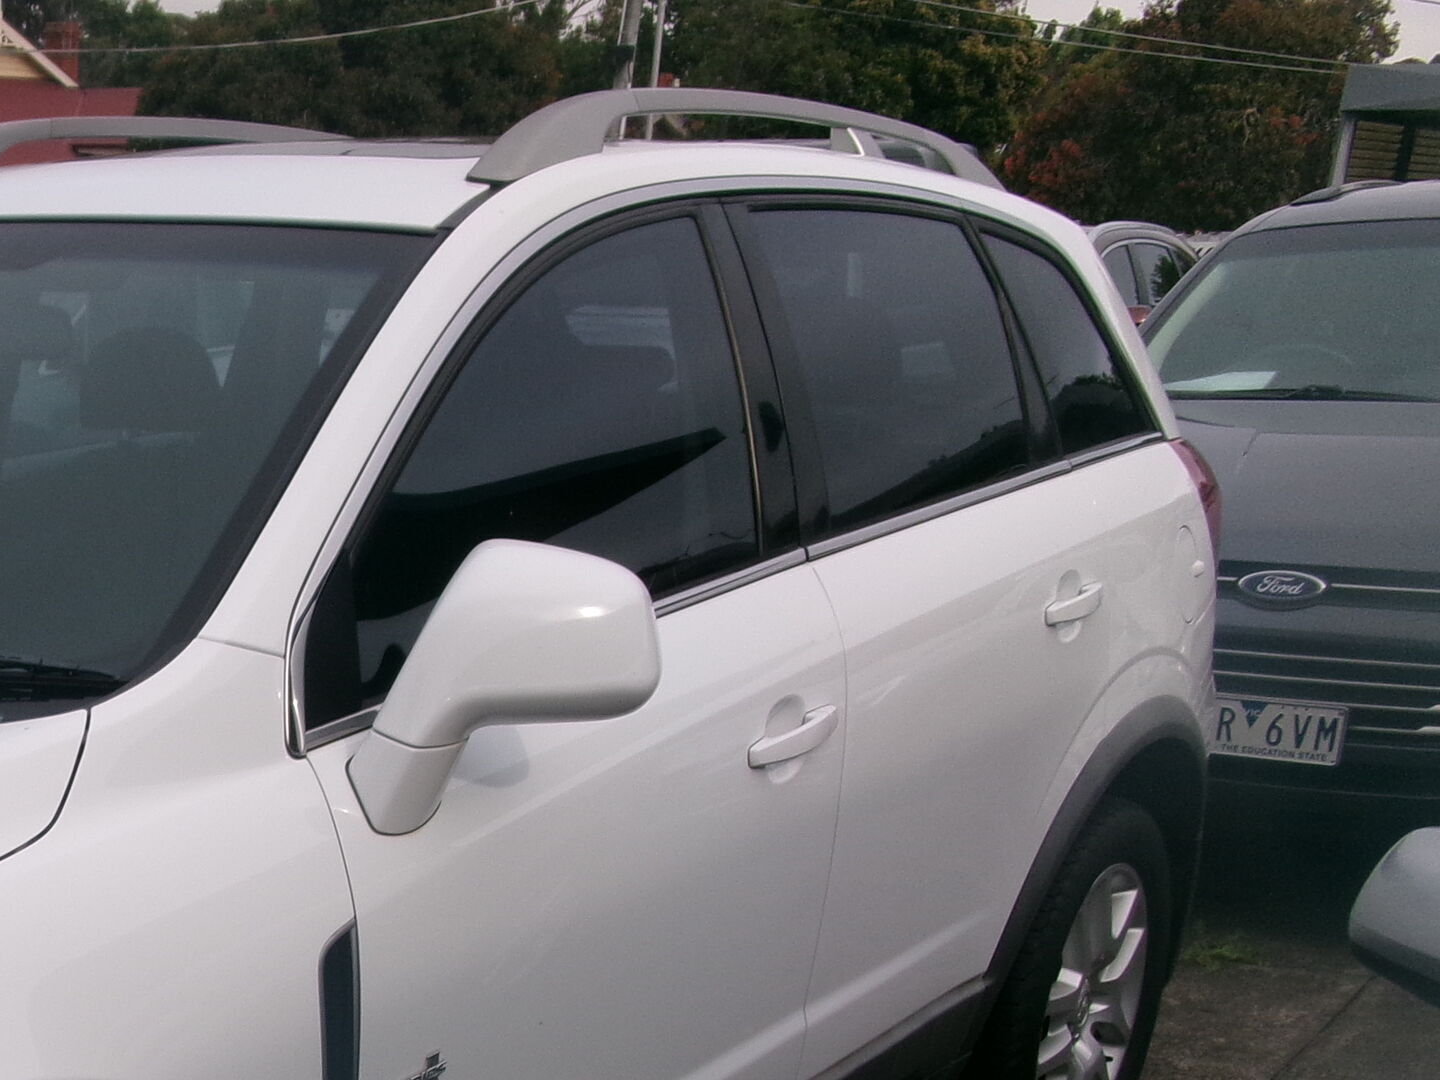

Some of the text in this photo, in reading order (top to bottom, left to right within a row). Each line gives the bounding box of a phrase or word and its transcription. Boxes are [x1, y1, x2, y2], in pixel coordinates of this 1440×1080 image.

[1256, 574, 1302, 595] Ford
[1265, 713, 1339, 753] 6VM
[1221, 743, 1327, 761] THE EDUCATION STATE
